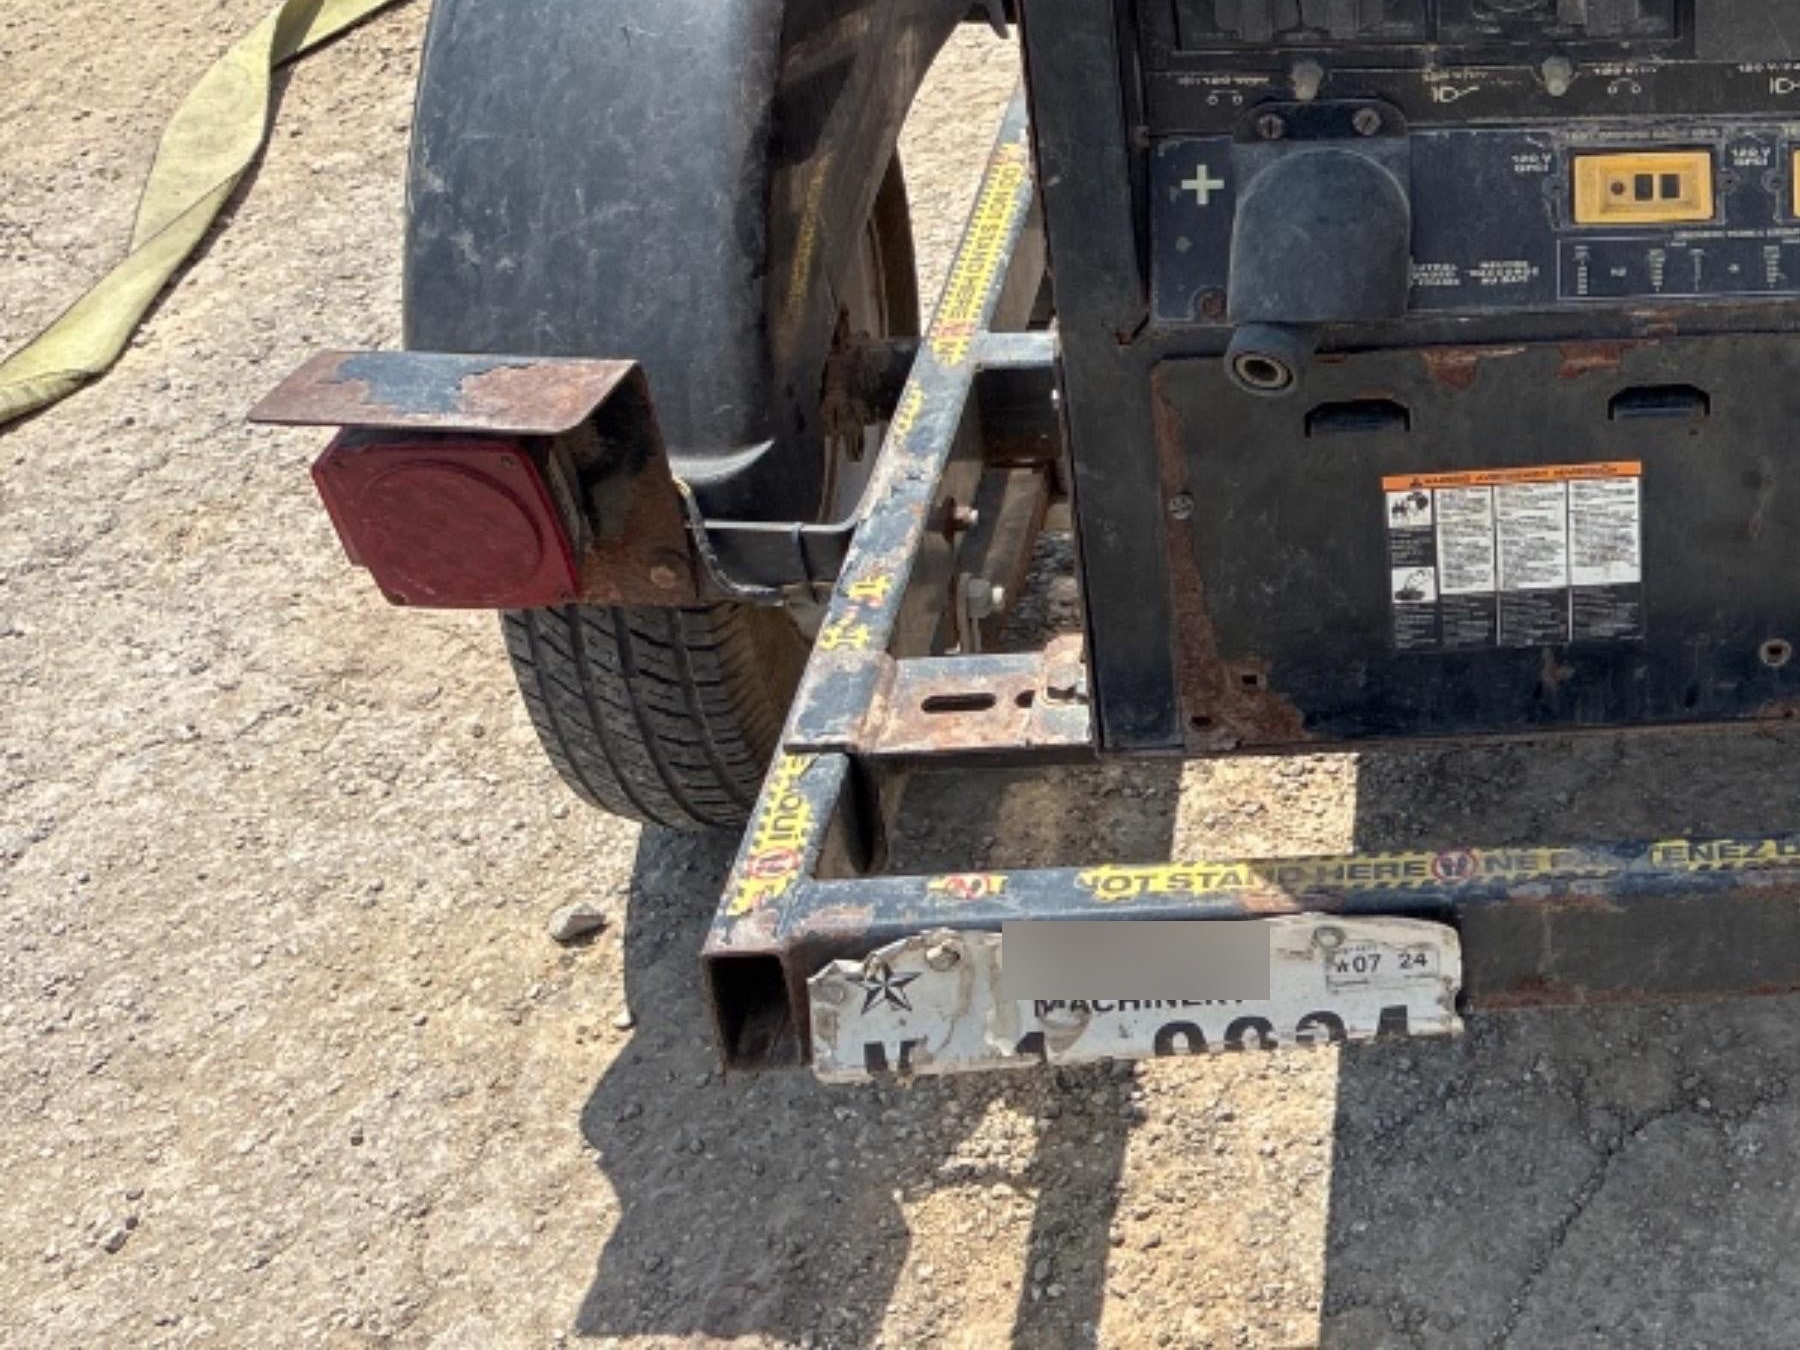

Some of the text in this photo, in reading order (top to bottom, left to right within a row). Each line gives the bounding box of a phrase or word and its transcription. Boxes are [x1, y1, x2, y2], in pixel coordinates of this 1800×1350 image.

[997, 167, 1020, 188] DO
[984, 191, 1013, 221] NOT
[968, 223, 1000, 275] STAND
[1316, 858, 1428, 881] HERE
[1398, 952, 1428, 970] 24
